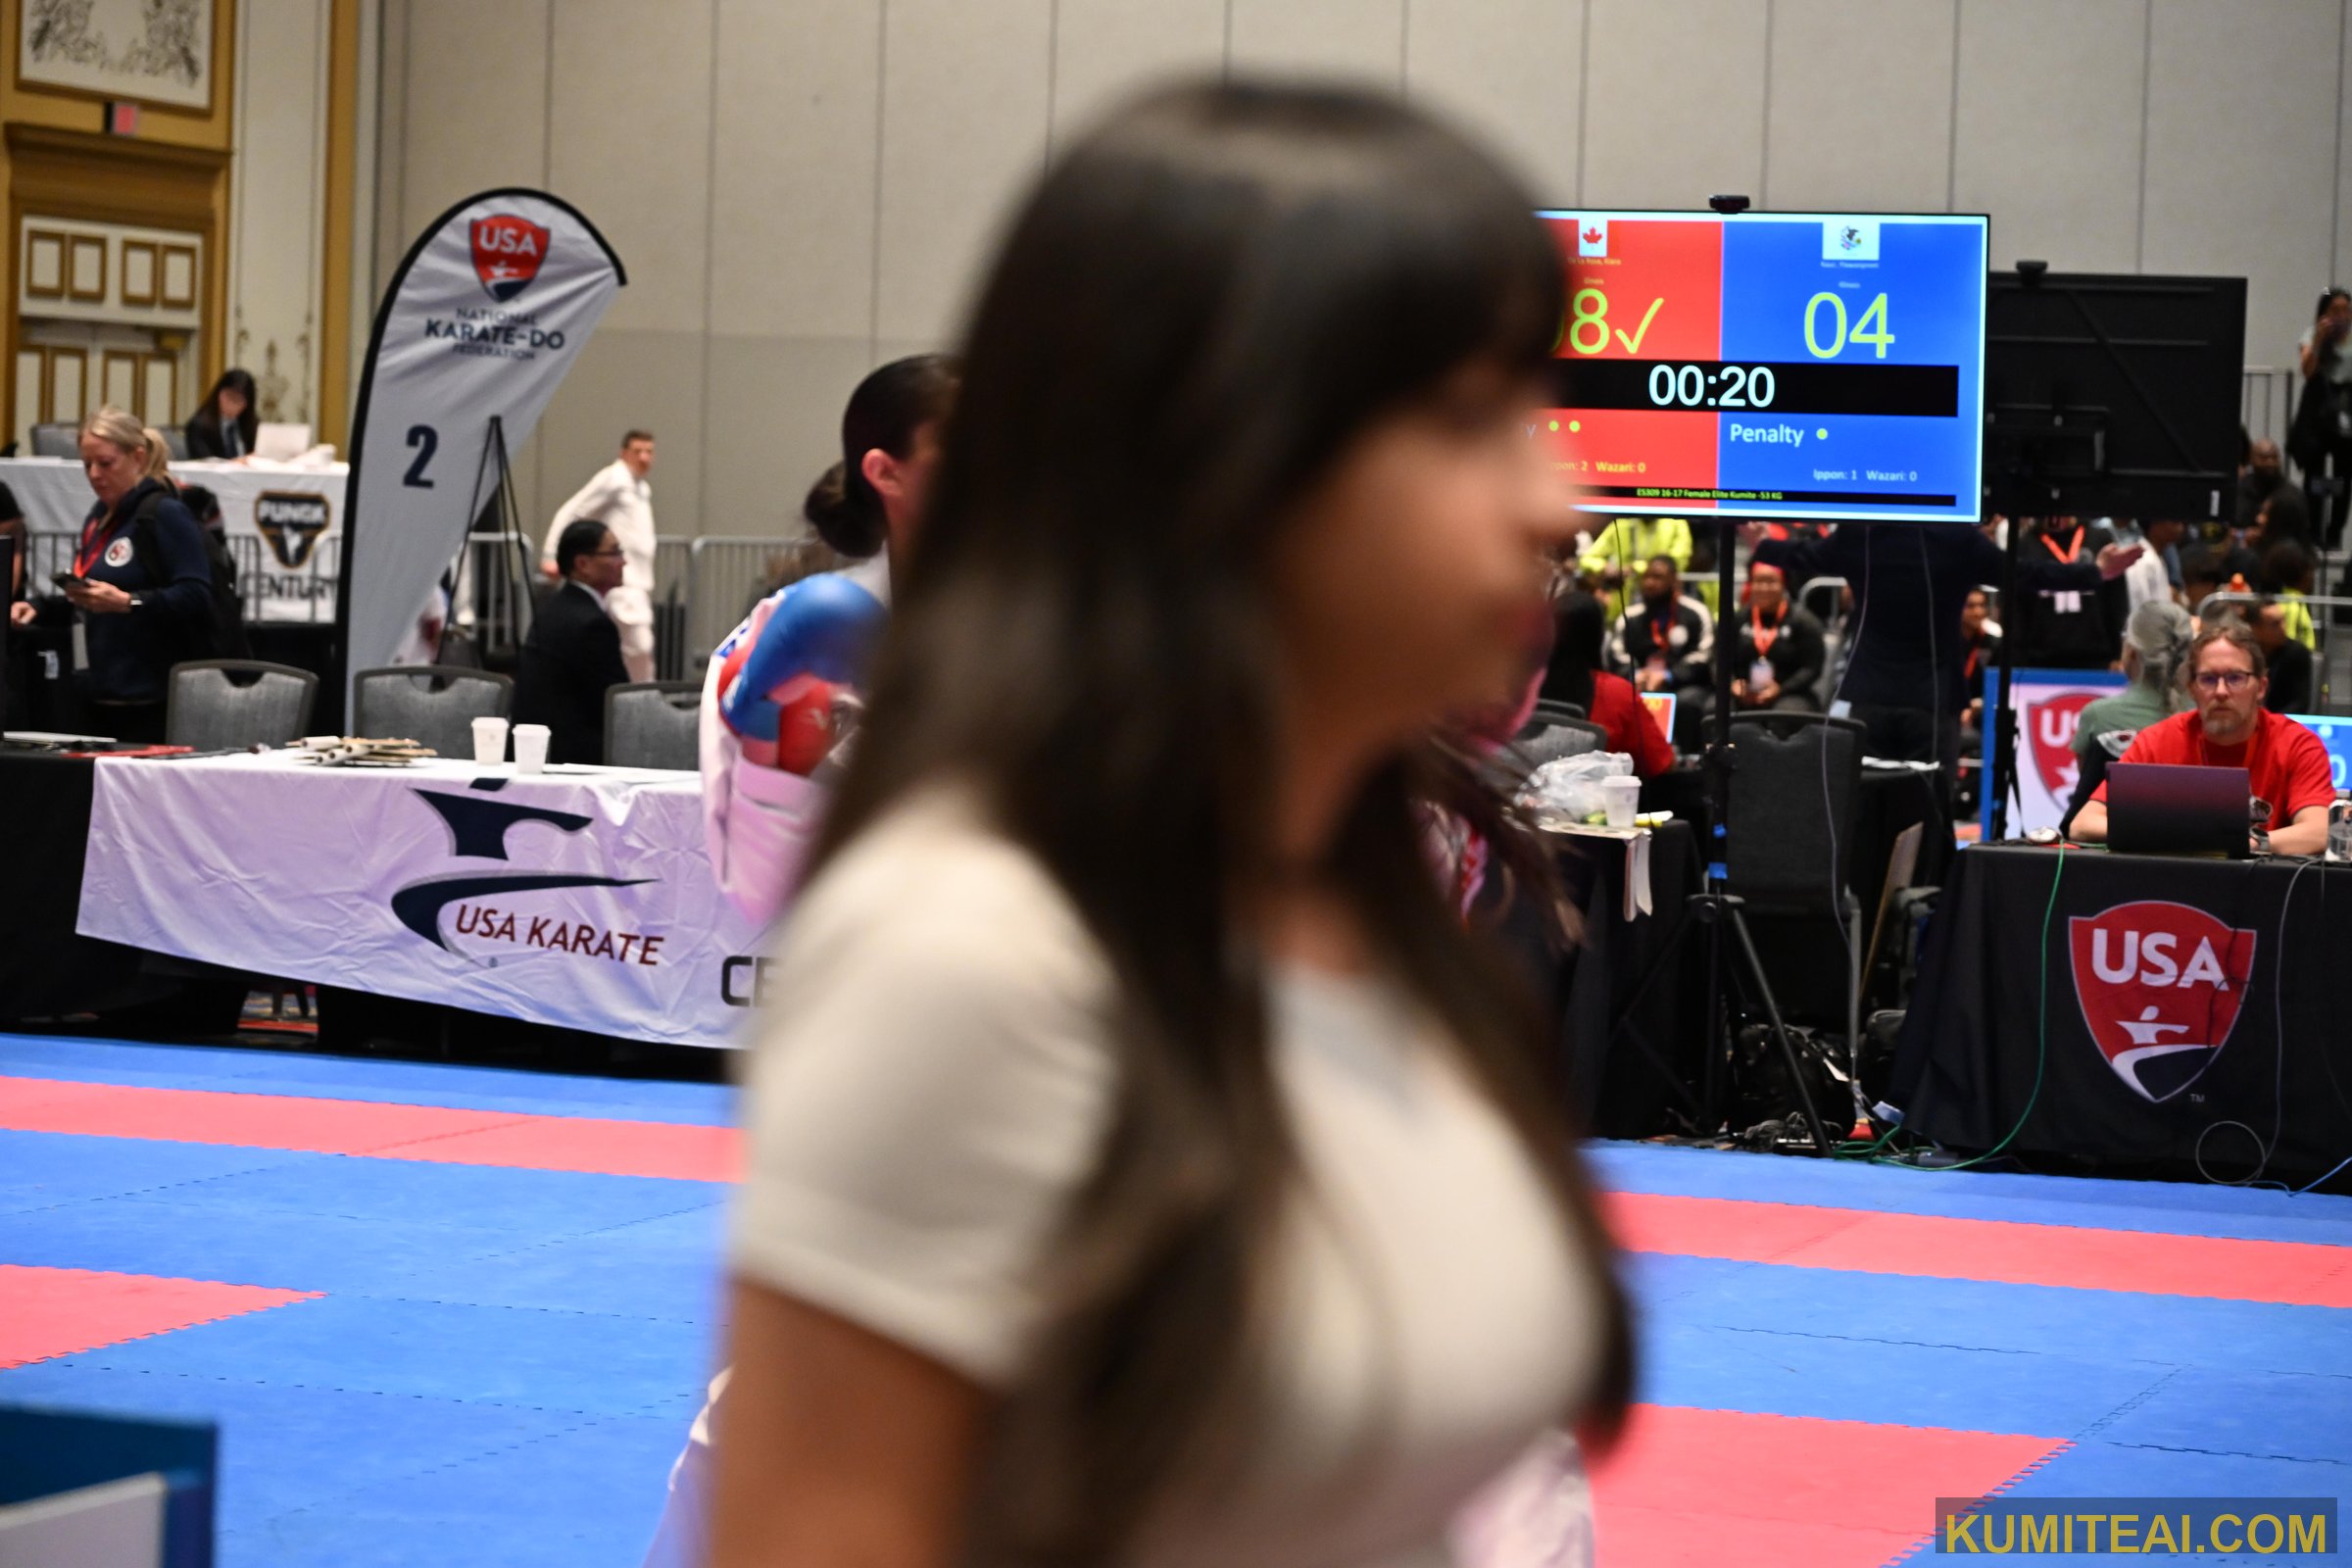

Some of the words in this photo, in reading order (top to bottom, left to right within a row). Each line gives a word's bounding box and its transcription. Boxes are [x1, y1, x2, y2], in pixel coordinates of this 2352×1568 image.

[479, 224, 537, 257] USA
[456, 307, 539, 325] NATIONAL
[1804, 292, 1895, 359] 04
[424, 318, 565, 350] KARATE-DO
[453, 342, 535, 361] FEDERATION
[1648, 365, 1776, 408] 00:20
[1730, 423, 1805, 448] Penalty
[403, 425, 438, 489] 2
[1581, 461, 1589, 471] 2
[1595, 462, 1636, 473] Wazari:
[1638, 462, 1646, 473] 0
[1813, 469, 1848, 481] Ippon:
[1851, 469, 1857, 480] 1
[1866, 470, 1907, 481] Wazari:
[1909, 471, 1918, 482] 0
[1662, 489, 1683, 498] 16-17
[1684, 489, 1711, 498] Female
[1712, 490, 1729, 499] Elite
[1730, 491, 1757, 500] Kumite
[1772, 492, 1784, 501] KG
[456, 904, 515, 942] USA
[526, 915, 664, 965] KARATE
[2091, 928, 2230, 991] USA
